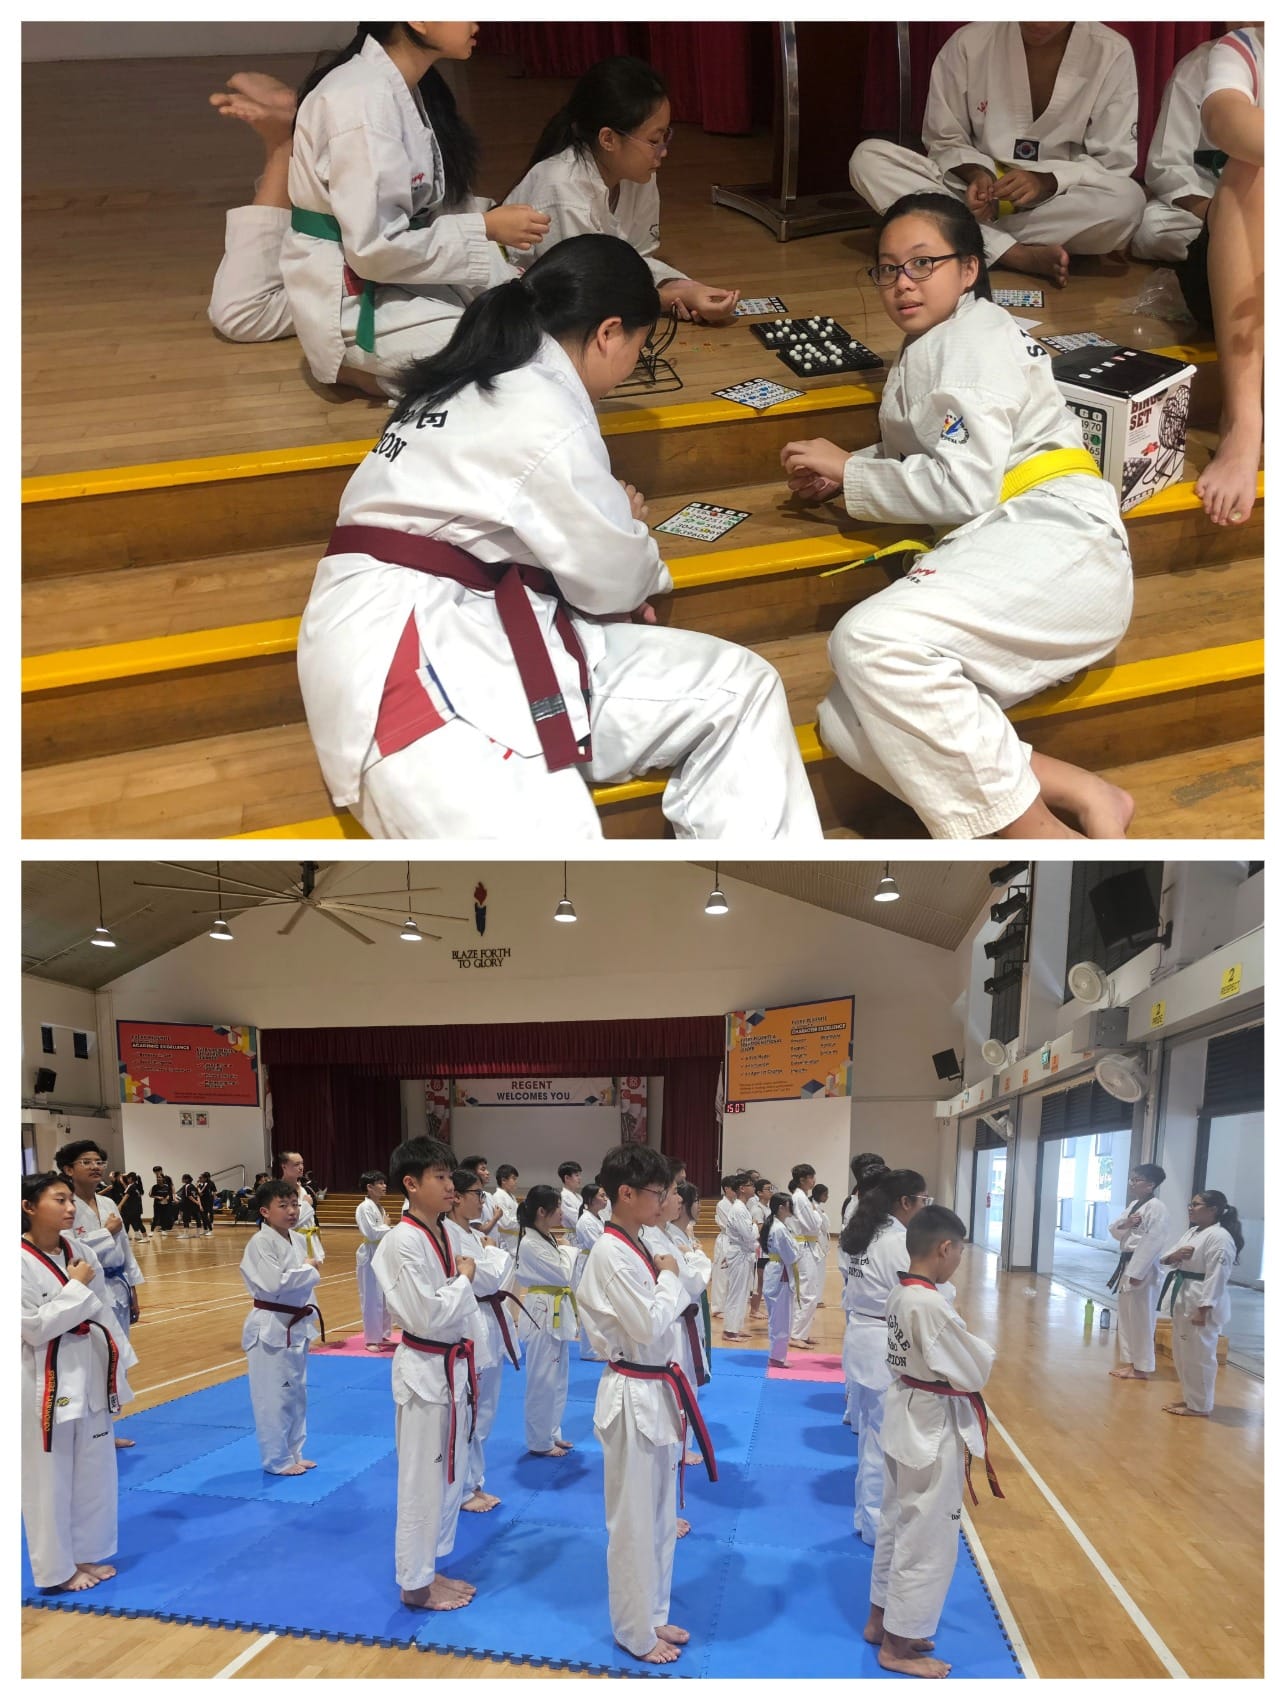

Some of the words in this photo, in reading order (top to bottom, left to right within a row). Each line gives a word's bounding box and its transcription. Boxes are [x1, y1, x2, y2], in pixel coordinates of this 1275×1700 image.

[1130, 407, 1152, 431] SET
[1091, 422, 1101, 432] 70
[452, 950, 478, 959] BLAZE
[480, 948, 511, 959] FORTH
[458, 959, 470, 968] TO
[474, 957, 504, 968] GLORY
[1228, 968, 1235, 982] 2
[511, 1080, 552, 1090] REGENT
[497, 1092, 548, 1101] WELCOMES
[550, 1092, 570, 1100] YOU
